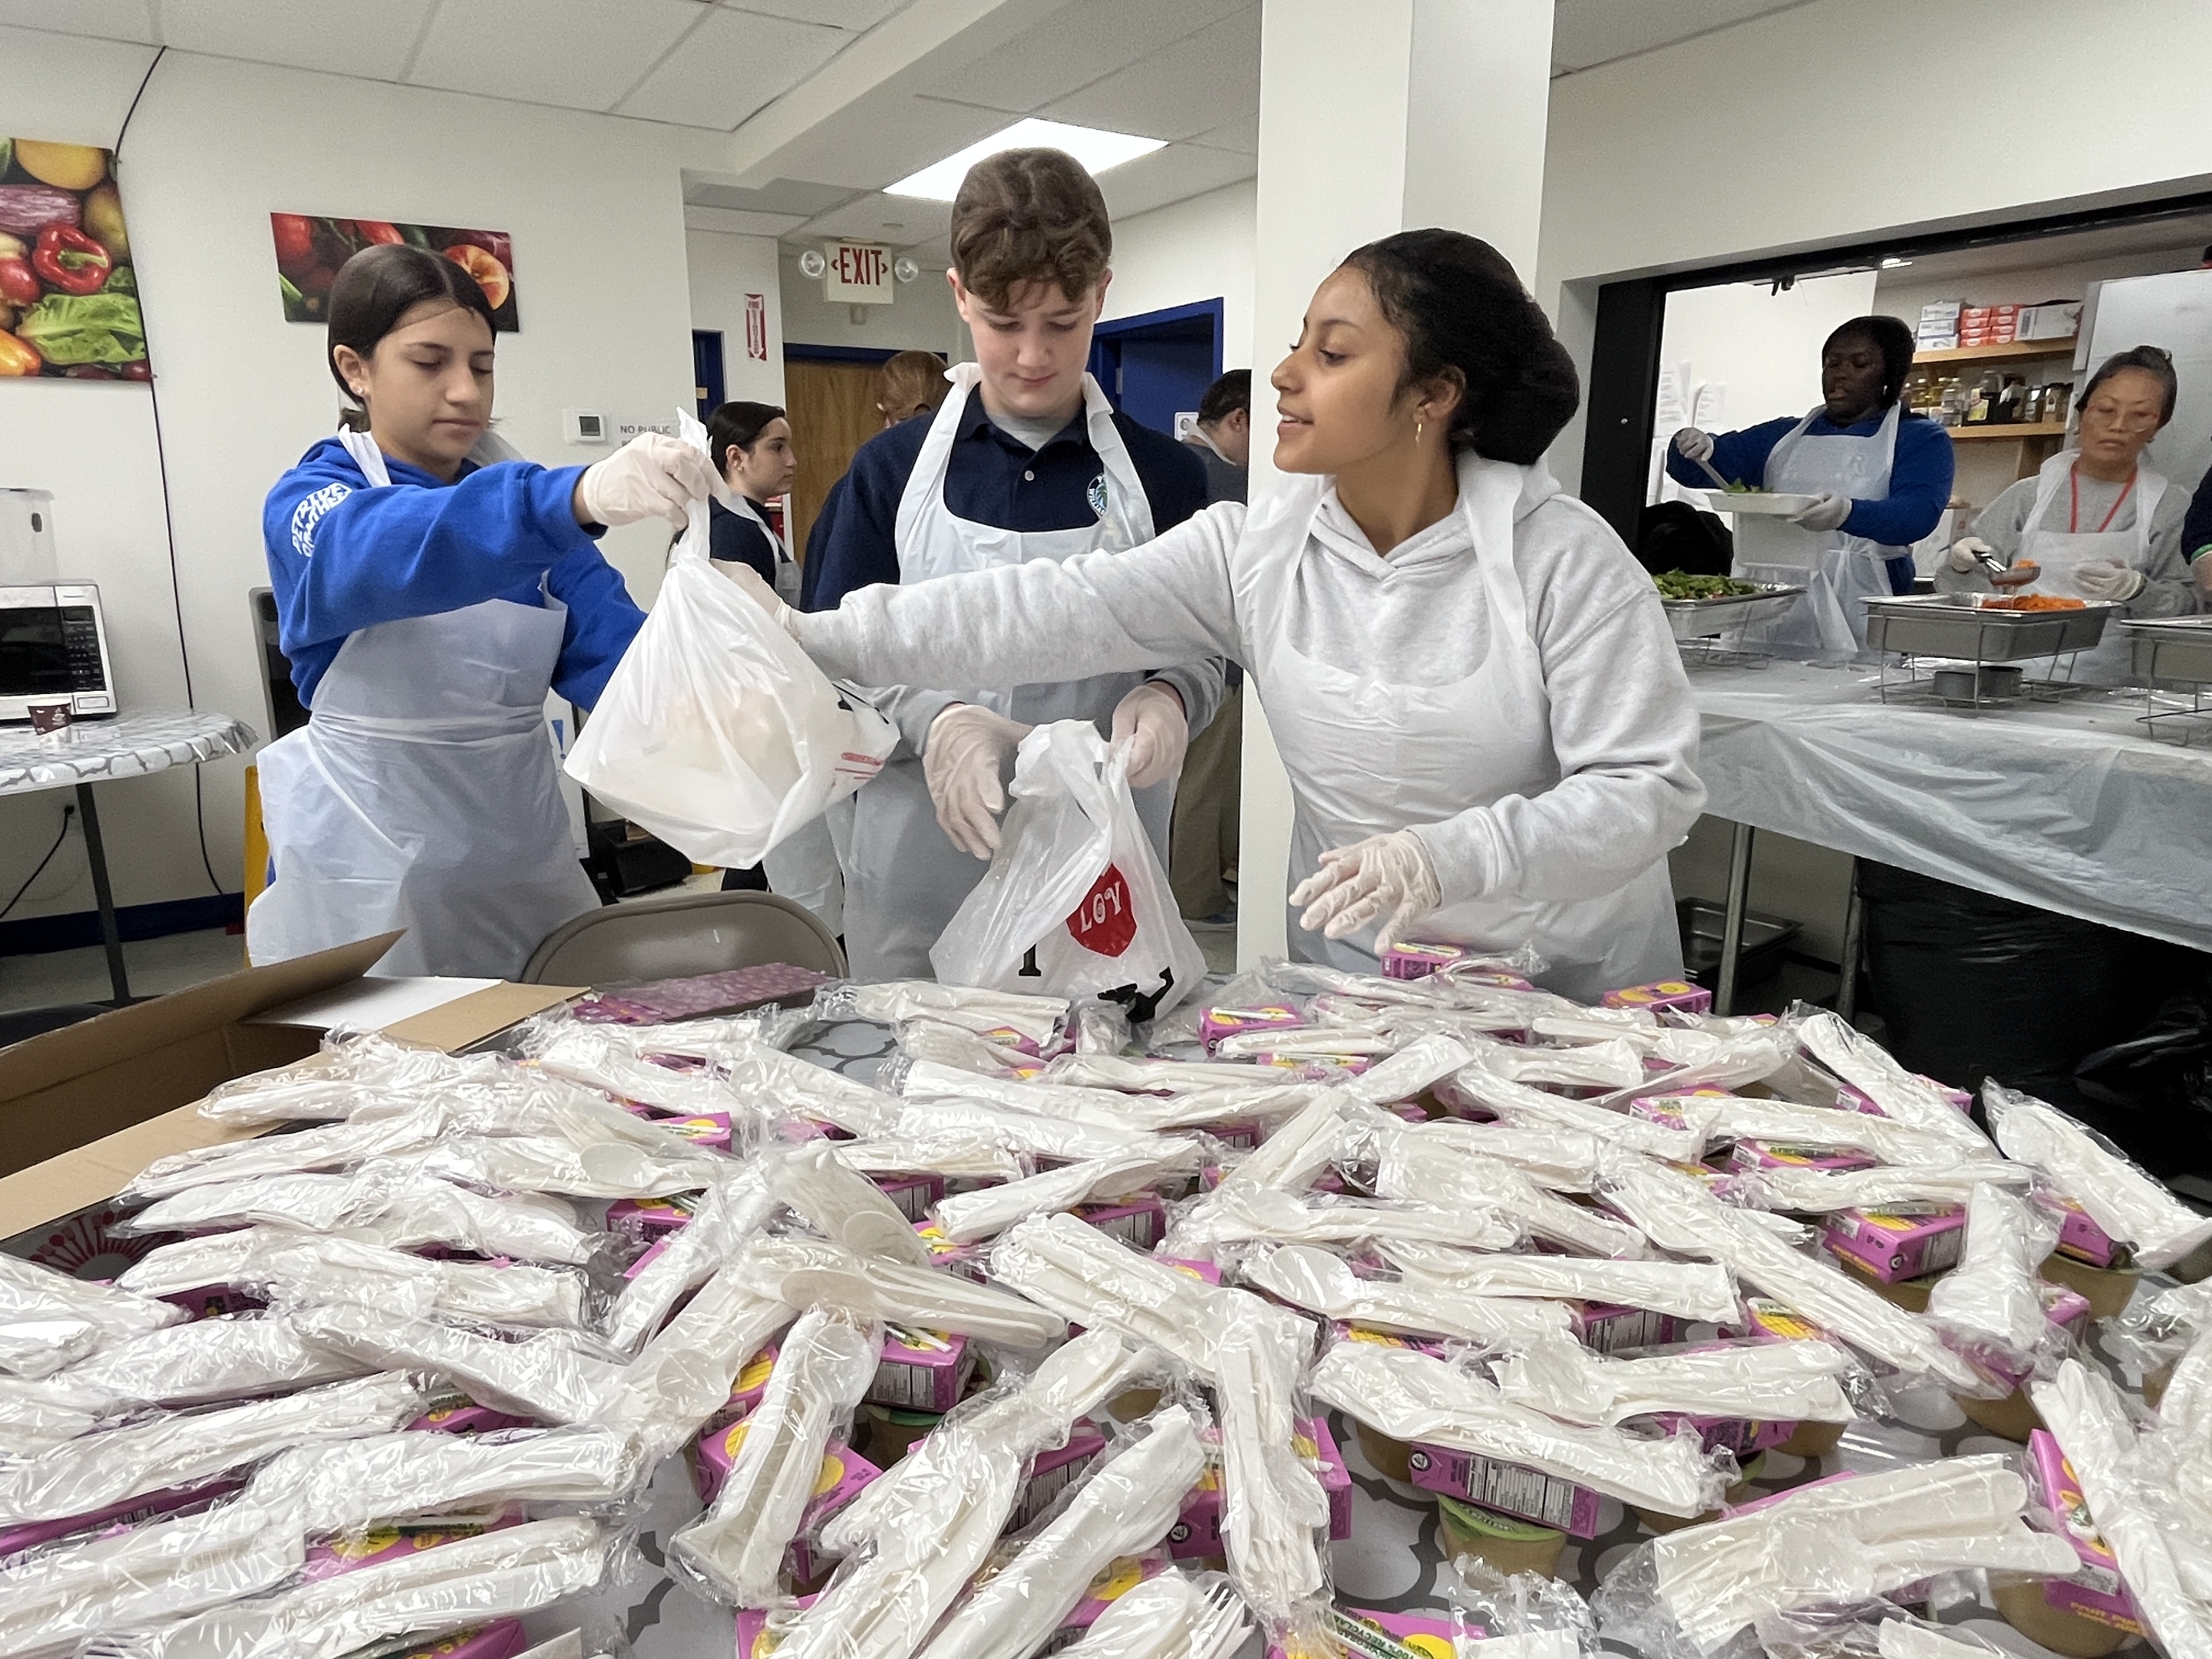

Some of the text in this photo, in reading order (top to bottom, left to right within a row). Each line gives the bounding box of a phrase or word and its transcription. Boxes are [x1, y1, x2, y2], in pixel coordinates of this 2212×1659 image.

[839, 247, 882, 286] EXIT
[620, 425, 672, 435] NO PUBLIC
[1081, 880, 1121, 934] LOV
[1334, 1615, 1386, 1648] RECYCLAB
